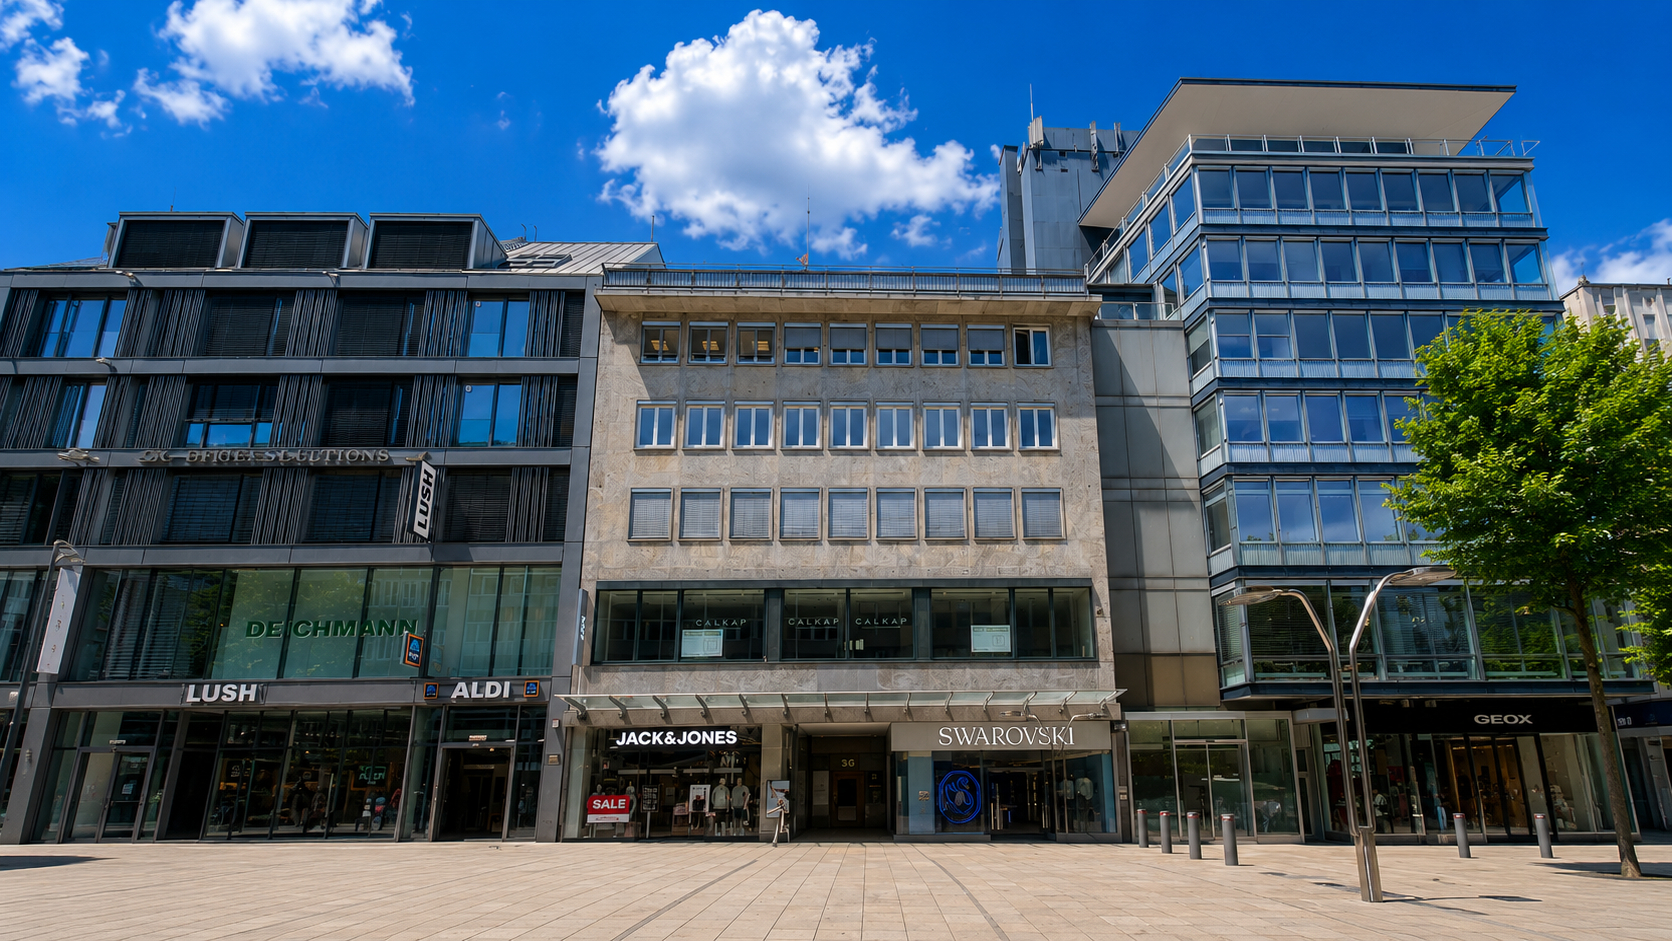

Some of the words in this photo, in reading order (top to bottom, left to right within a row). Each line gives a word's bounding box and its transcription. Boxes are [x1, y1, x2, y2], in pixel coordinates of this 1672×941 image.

[416, 470, 435, 531] LUSH
[245, 619, 419, 639] DEICHMANN
[695, 618, 747, 627] CALKAP
[788, 617, 839, 626] CALKAP
[855, 617, 907, 626] CALKAP
[185, 683, 258, 703] LUSH
[450, 680, 511, 700] ALDI
[1473, 713, 1534, 725] GEOX
[615, 730, 738, 746] JACK&JONES
[938, 726, 1075, 746] SWAROVSKI
[592, 798, 626, 810] SALE
